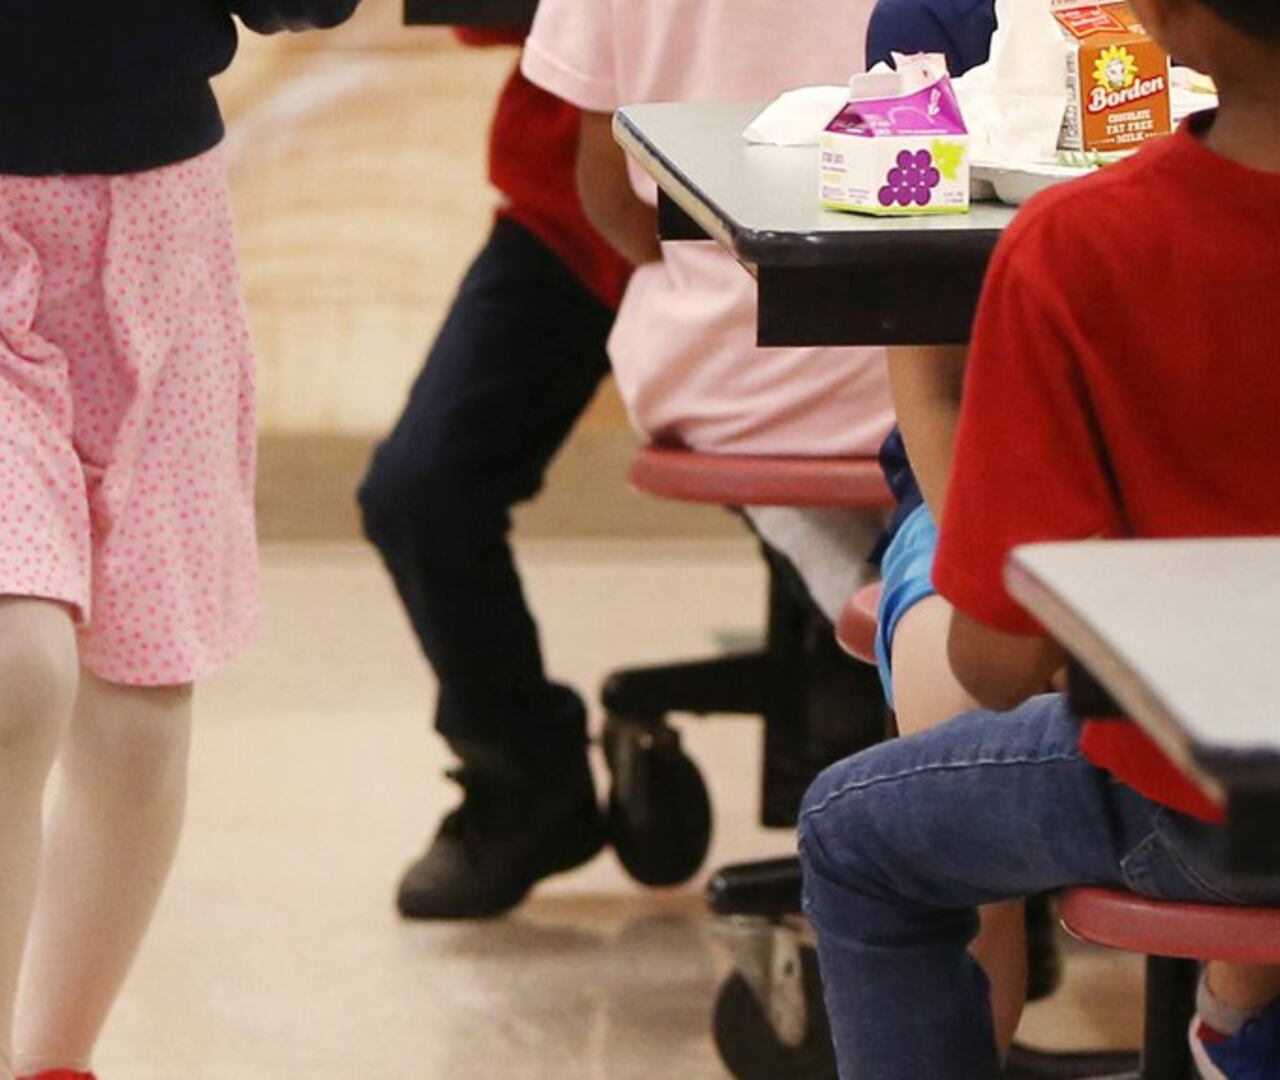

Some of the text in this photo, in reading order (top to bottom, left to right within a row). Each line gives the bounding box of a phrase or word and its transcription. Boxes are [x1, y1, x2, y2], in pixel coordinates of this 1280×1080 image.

[1088, 76, 1165, 112] Borden
[1106, 124, 1126, 135] FAT
[1116, 133, 1146, 144] MILK
